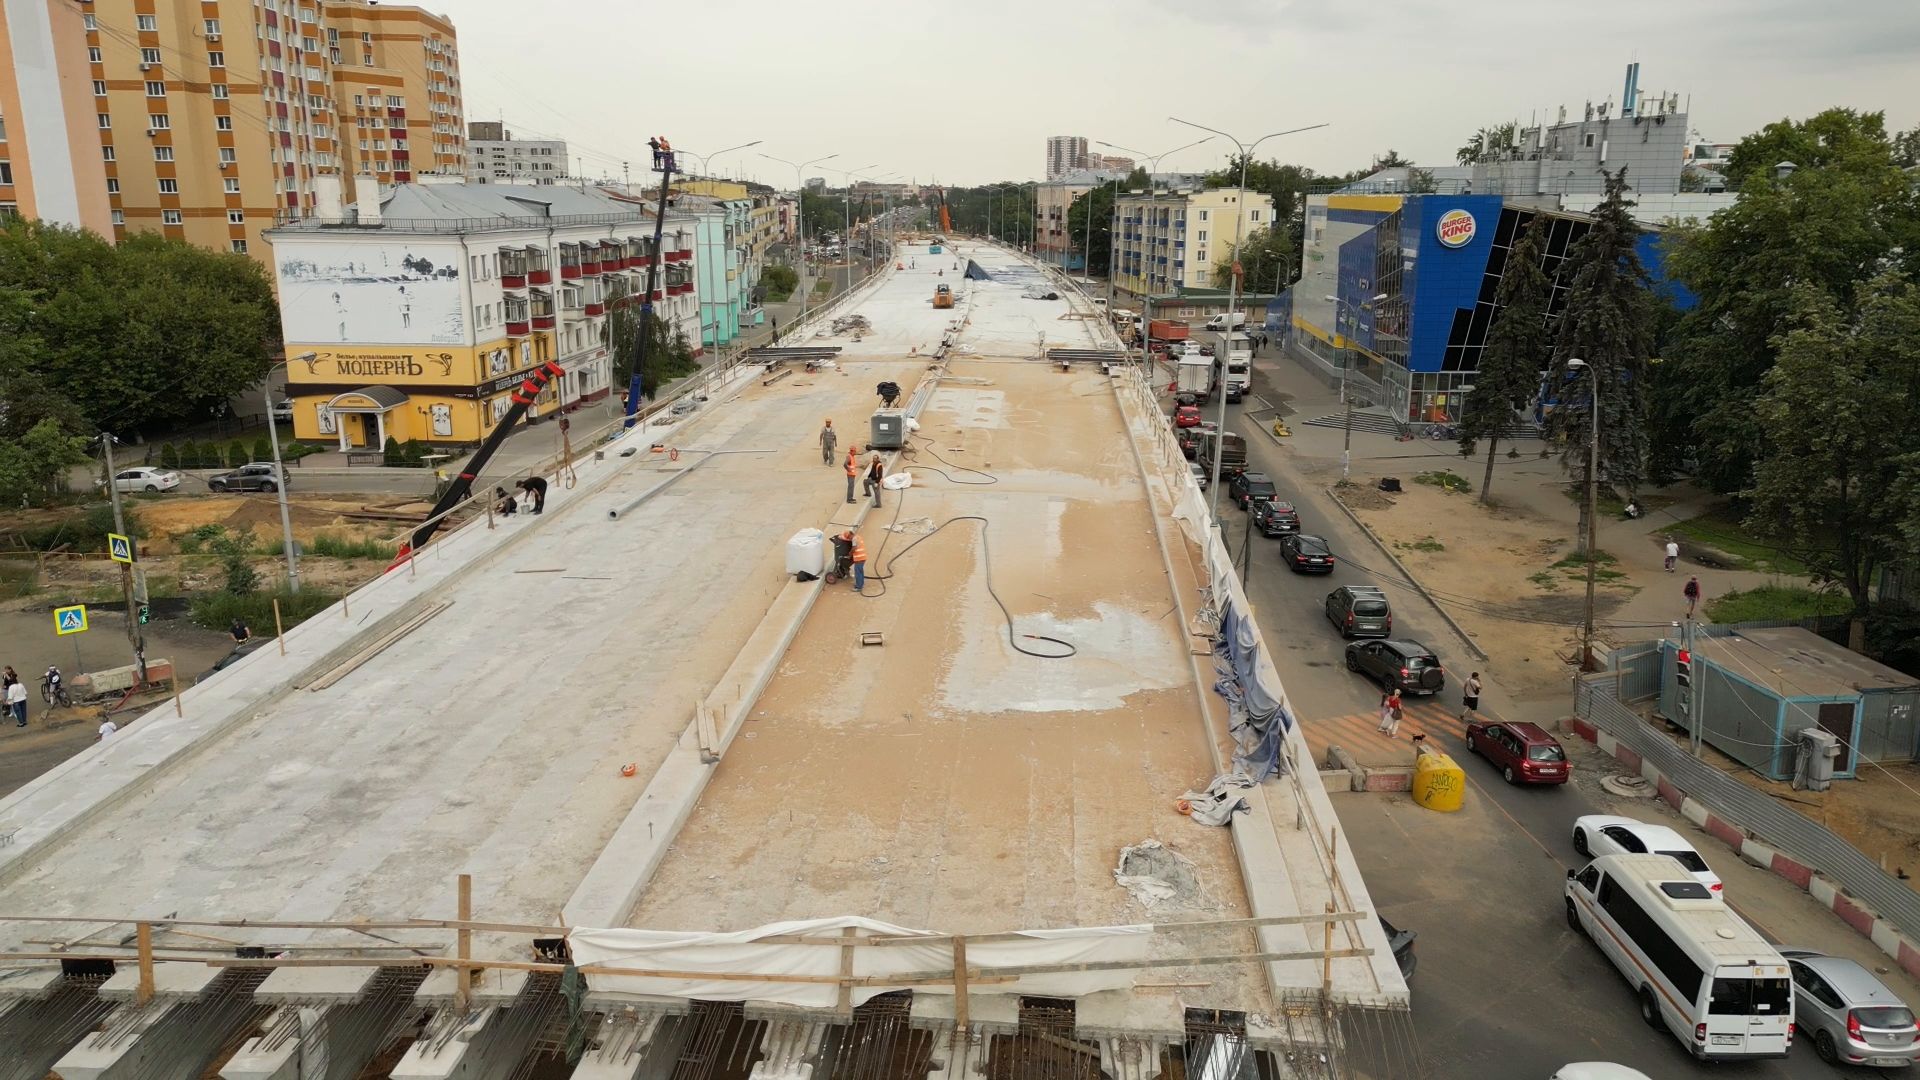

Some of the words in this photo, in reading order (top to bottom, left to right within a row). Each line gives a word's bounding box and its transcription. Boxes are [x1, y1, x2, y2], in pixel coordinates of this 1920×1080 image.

[1441, 216, 1472, 230] BURGER
[1442, 222, 1472, 239] KING
[336, 355, 423, 376] МОДЕРНЪ
